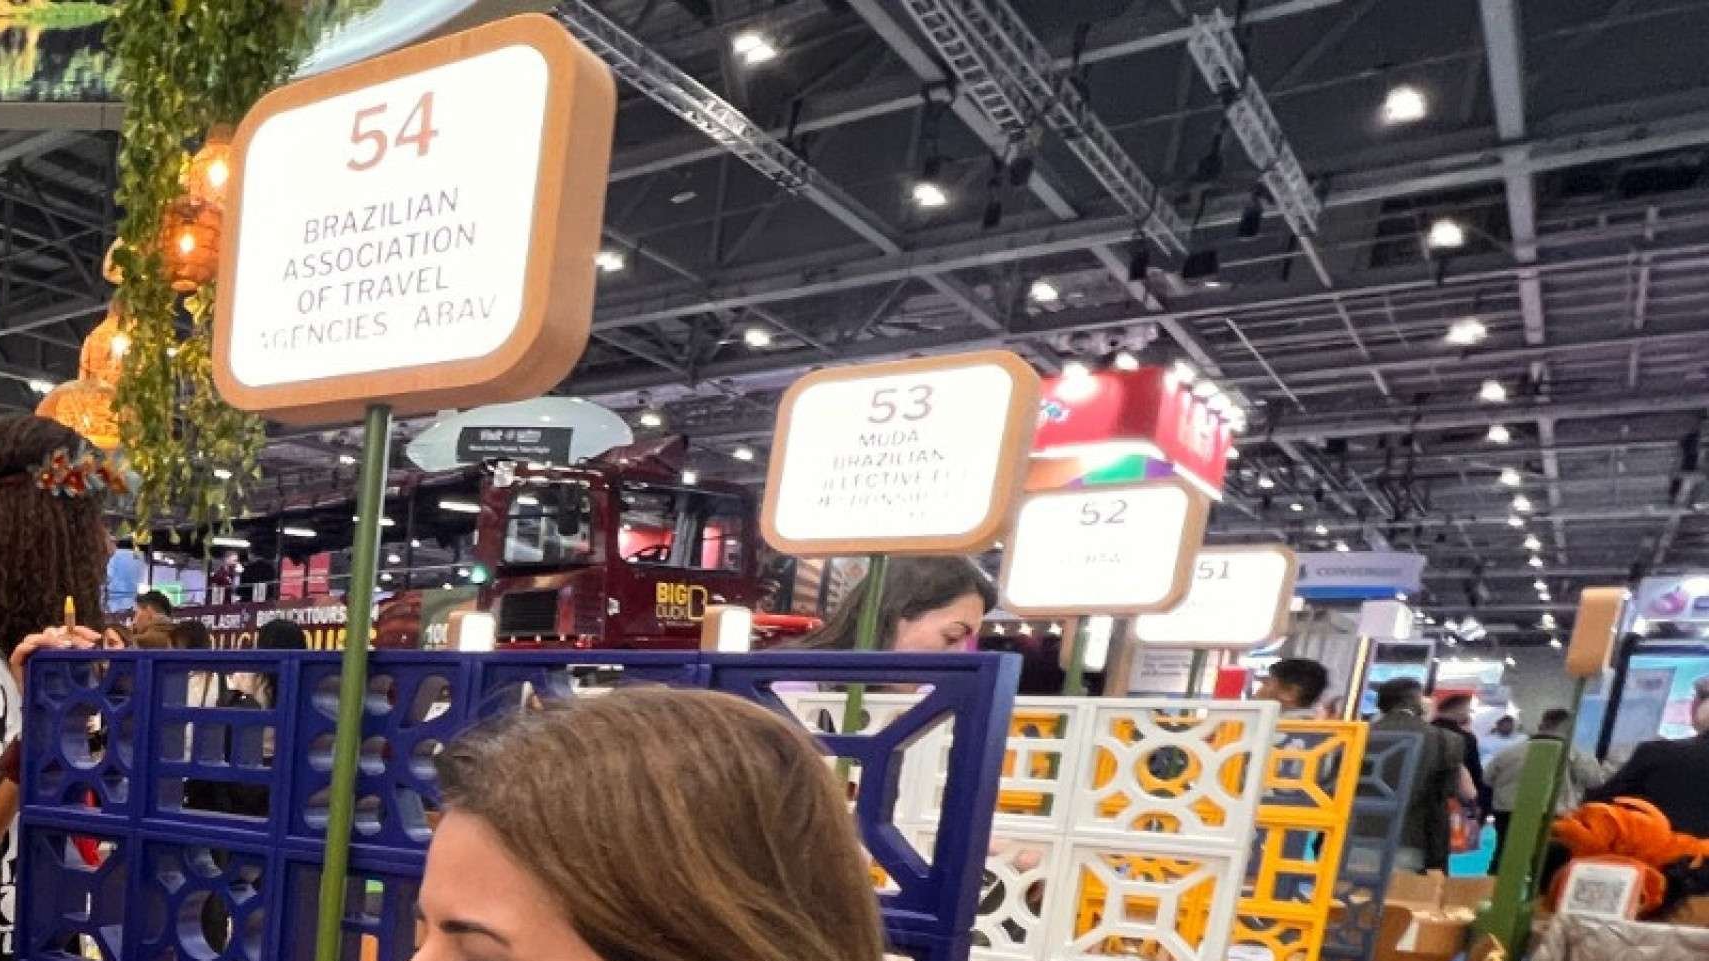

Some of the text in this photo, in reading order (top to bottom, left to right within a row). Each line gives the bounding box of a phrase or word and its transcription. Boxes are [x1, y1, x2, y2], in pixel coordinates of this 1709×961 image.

[346, 91, 439, 171] 54
[302, 185, 460, 245] BRAZILIAN
[282, 221, 477, 282] ASSOCIATION
[297, 265, 450, 315] OF TRAVEL
[867, 384, 935, 424] 53
[858, 429, 920, 448] MUDA
[1078, 498, 1129, 527] 52
[1195, 558, 1232, 581] 51
[655, 582, 687, 605] BIG
